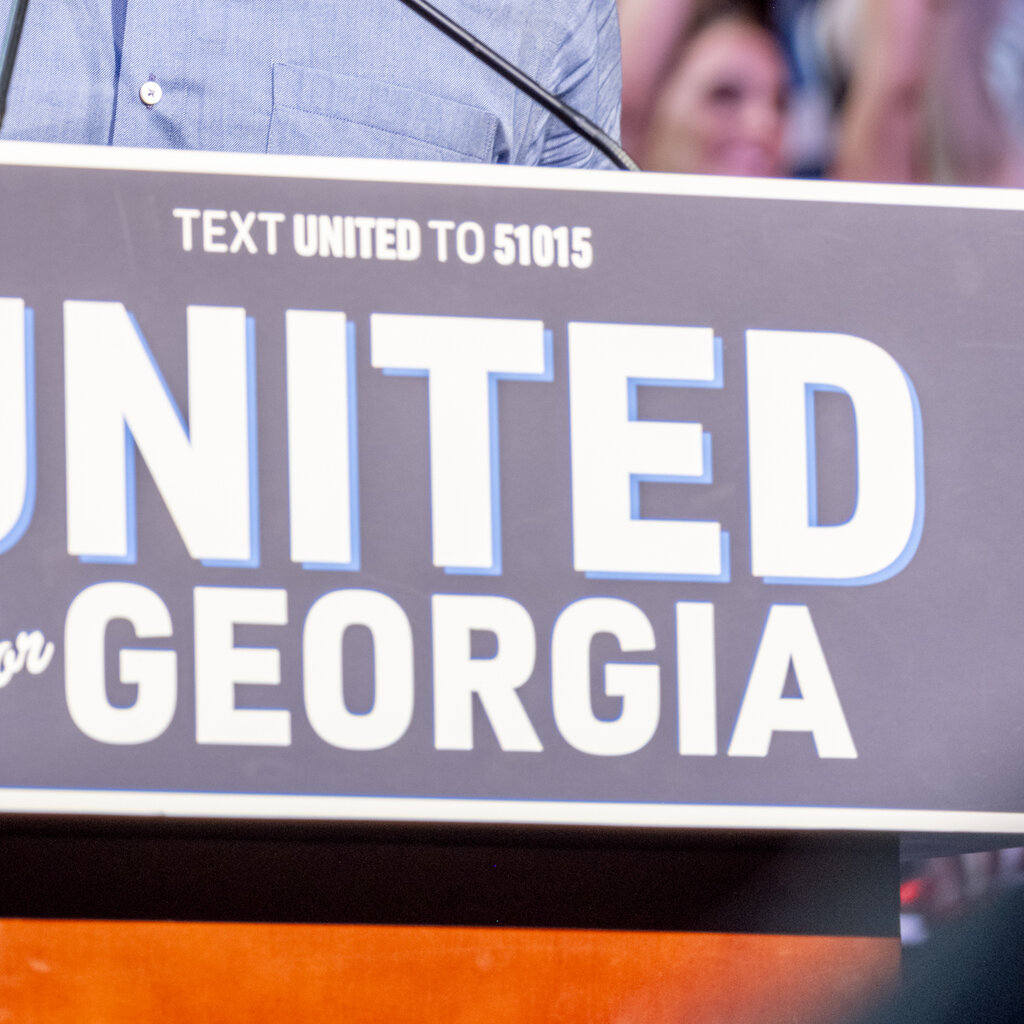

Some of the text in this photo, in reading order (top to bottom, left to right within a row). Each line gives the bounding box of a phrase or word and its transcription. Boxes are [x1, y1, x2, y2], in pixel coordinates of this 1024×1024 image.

[172, 208, 593, 269] TEXT UNITED TO 51015
[64, 582, 858, 759] GEORGIA
